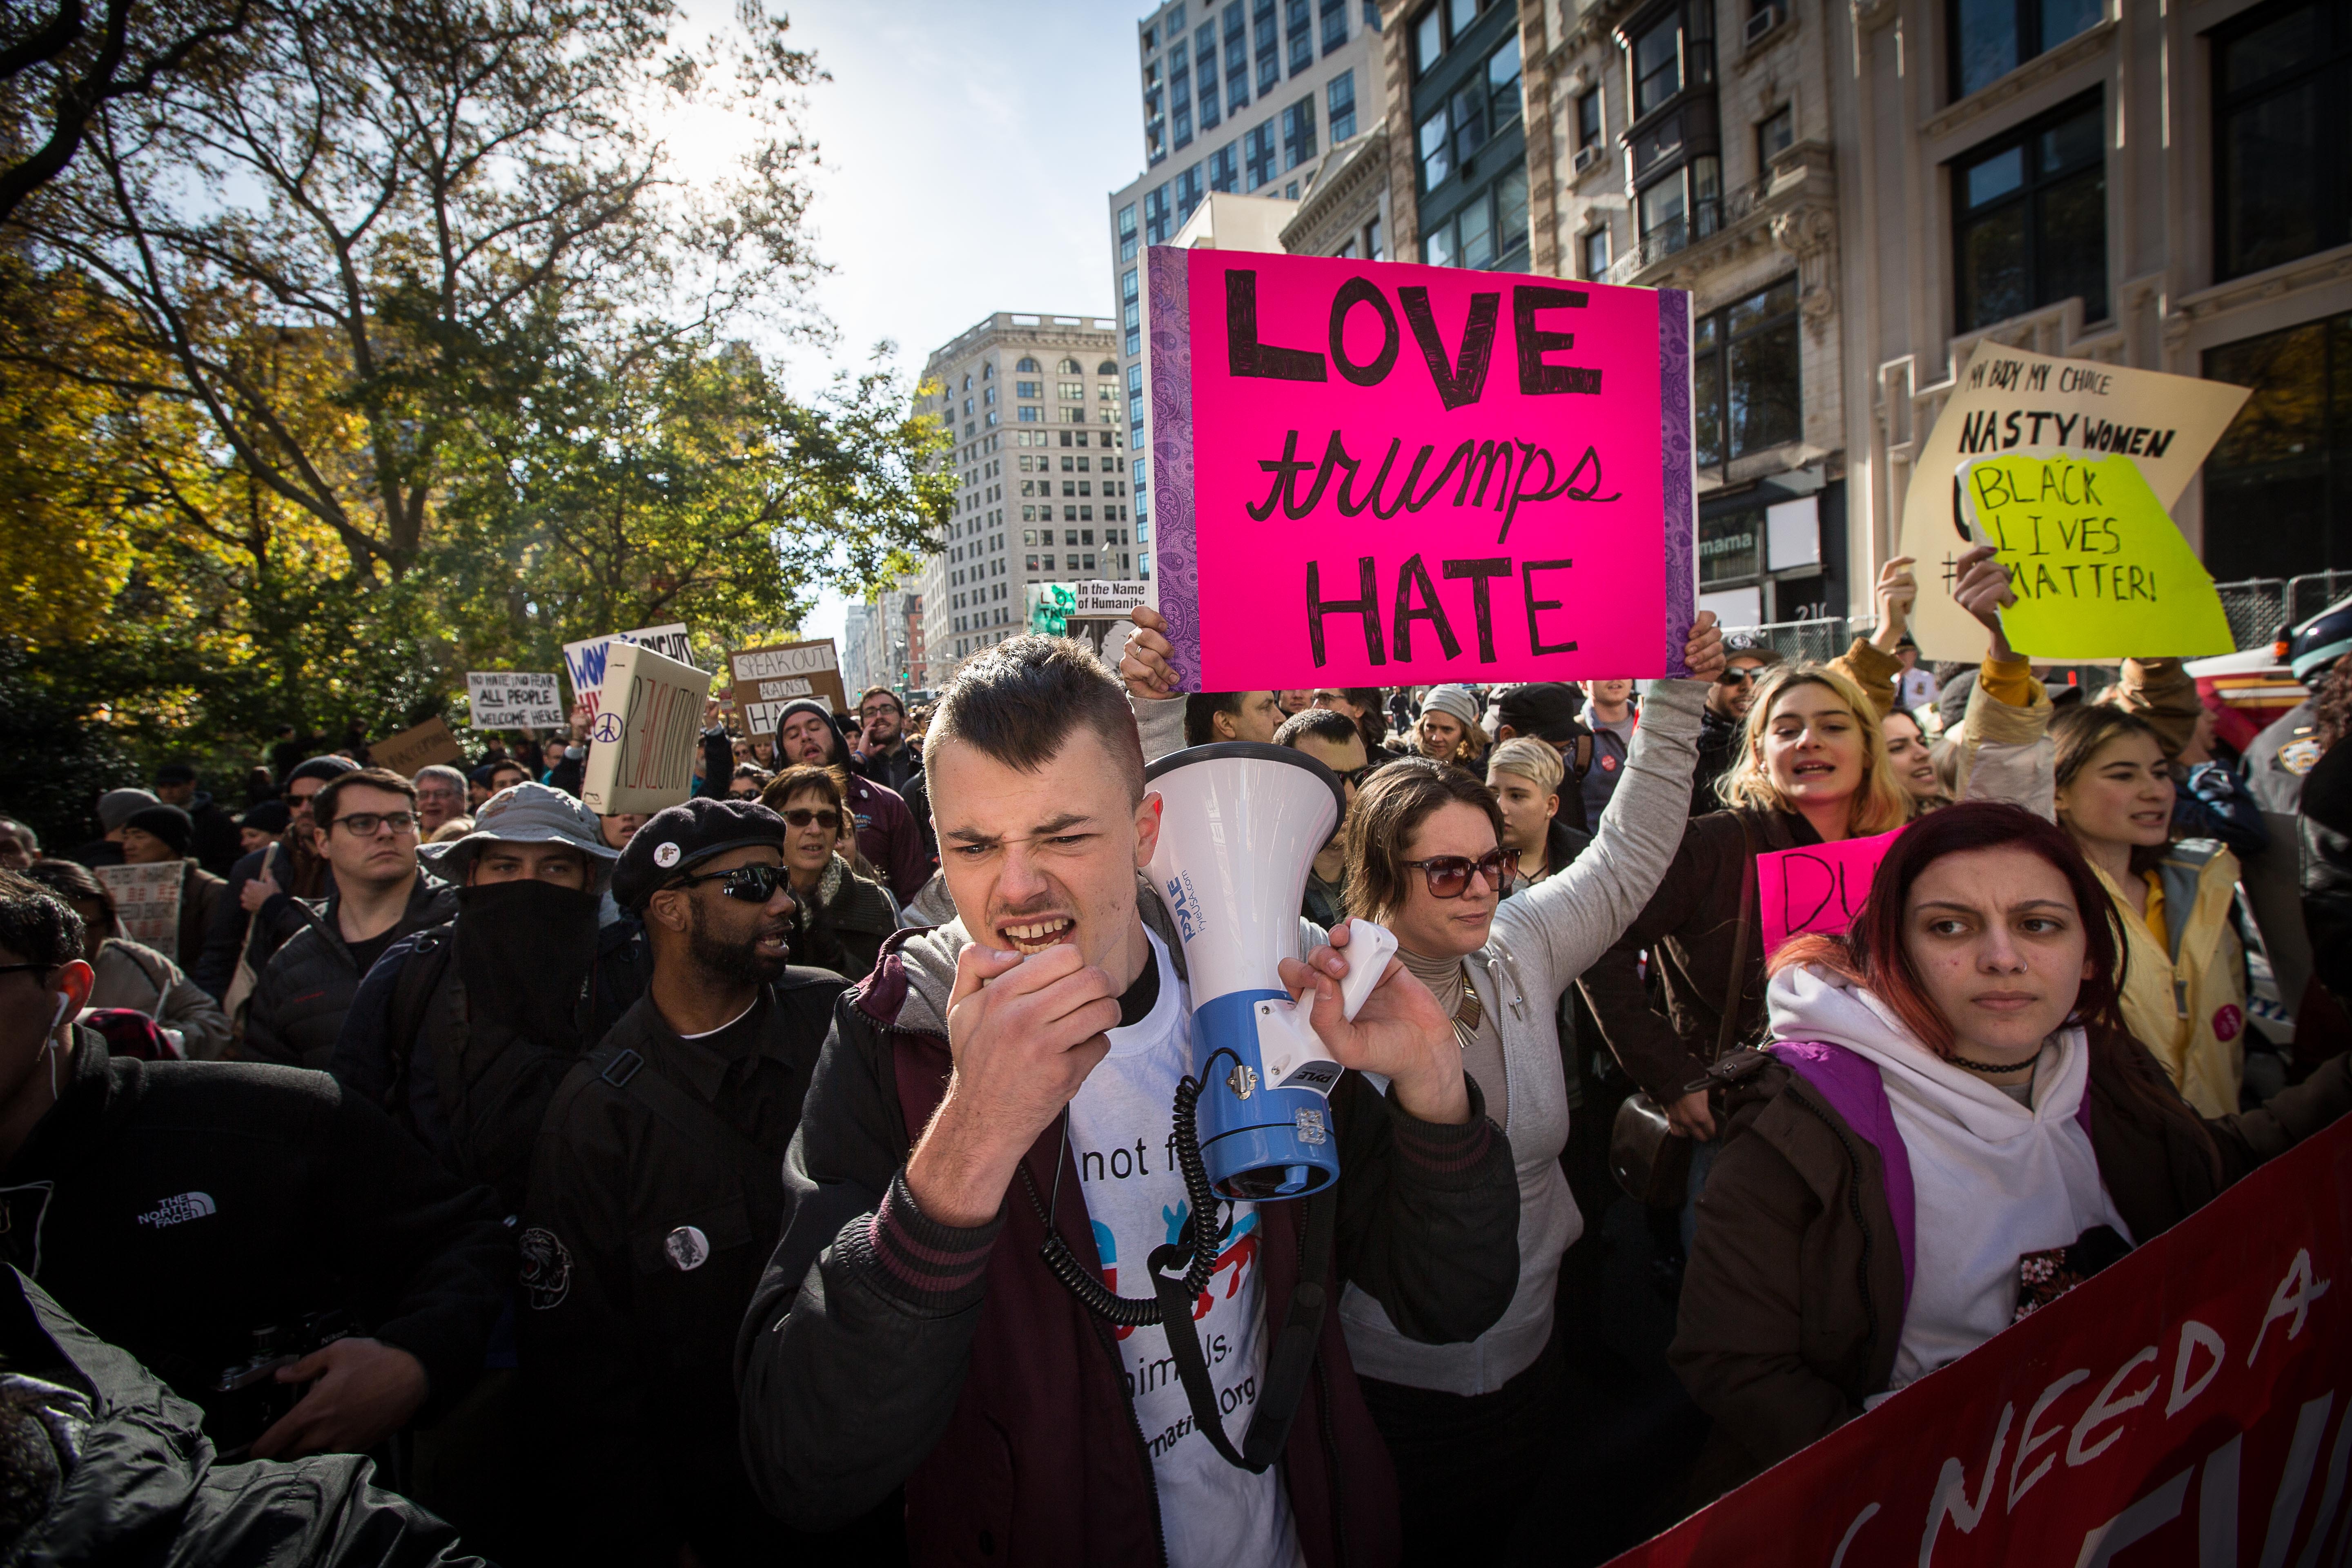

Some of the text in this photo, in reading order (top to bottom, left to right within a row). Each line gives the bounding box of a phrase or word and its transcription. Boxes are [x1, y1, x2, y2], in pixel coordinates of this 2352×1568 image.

[1225, 270, 1603, 412] LOVE
[1966, 359, 2113, 395] MY BODY MY CHOICE
[1958, 410, 2176, 458] NASTY WOMEN
[1246, 430, 1622, 544] trumps
[1975, 464, 2103, 510] BLACK
[1996, 514, 2120, 556] LIVES
[1078, 583, 1145, 595] In the Name
[2005, 562, 2157, 602] MATTER!
[1078, 597, 1145, 609] of Humanity
[1306, 553, 1578, 668] HATE
[738, 646, 827, 677] SPEAK OUT
[470, 675, 482, 686] NO
[531, 674, 556, 688] FEAR
[761, 678, 808, 696] AGAINST
[479, 688, 552, 705] ALL PEOPLE
[476, 709, 562, 725] WELCOME HERE
[1296, 1071, 1334, 1083] PYLE
[1082, 1137, 1149, 1182] not
[138, 1201, 190, 1225] NORTH
[158, 1194, 188, 1208] THE
[155, 1210, 192, 1229] FACE
[321, 1329, 349, 1346] Nikon
[1918, 1319, 2226, 1568] NEED
[2247, 1247, 2331, 1370] A
